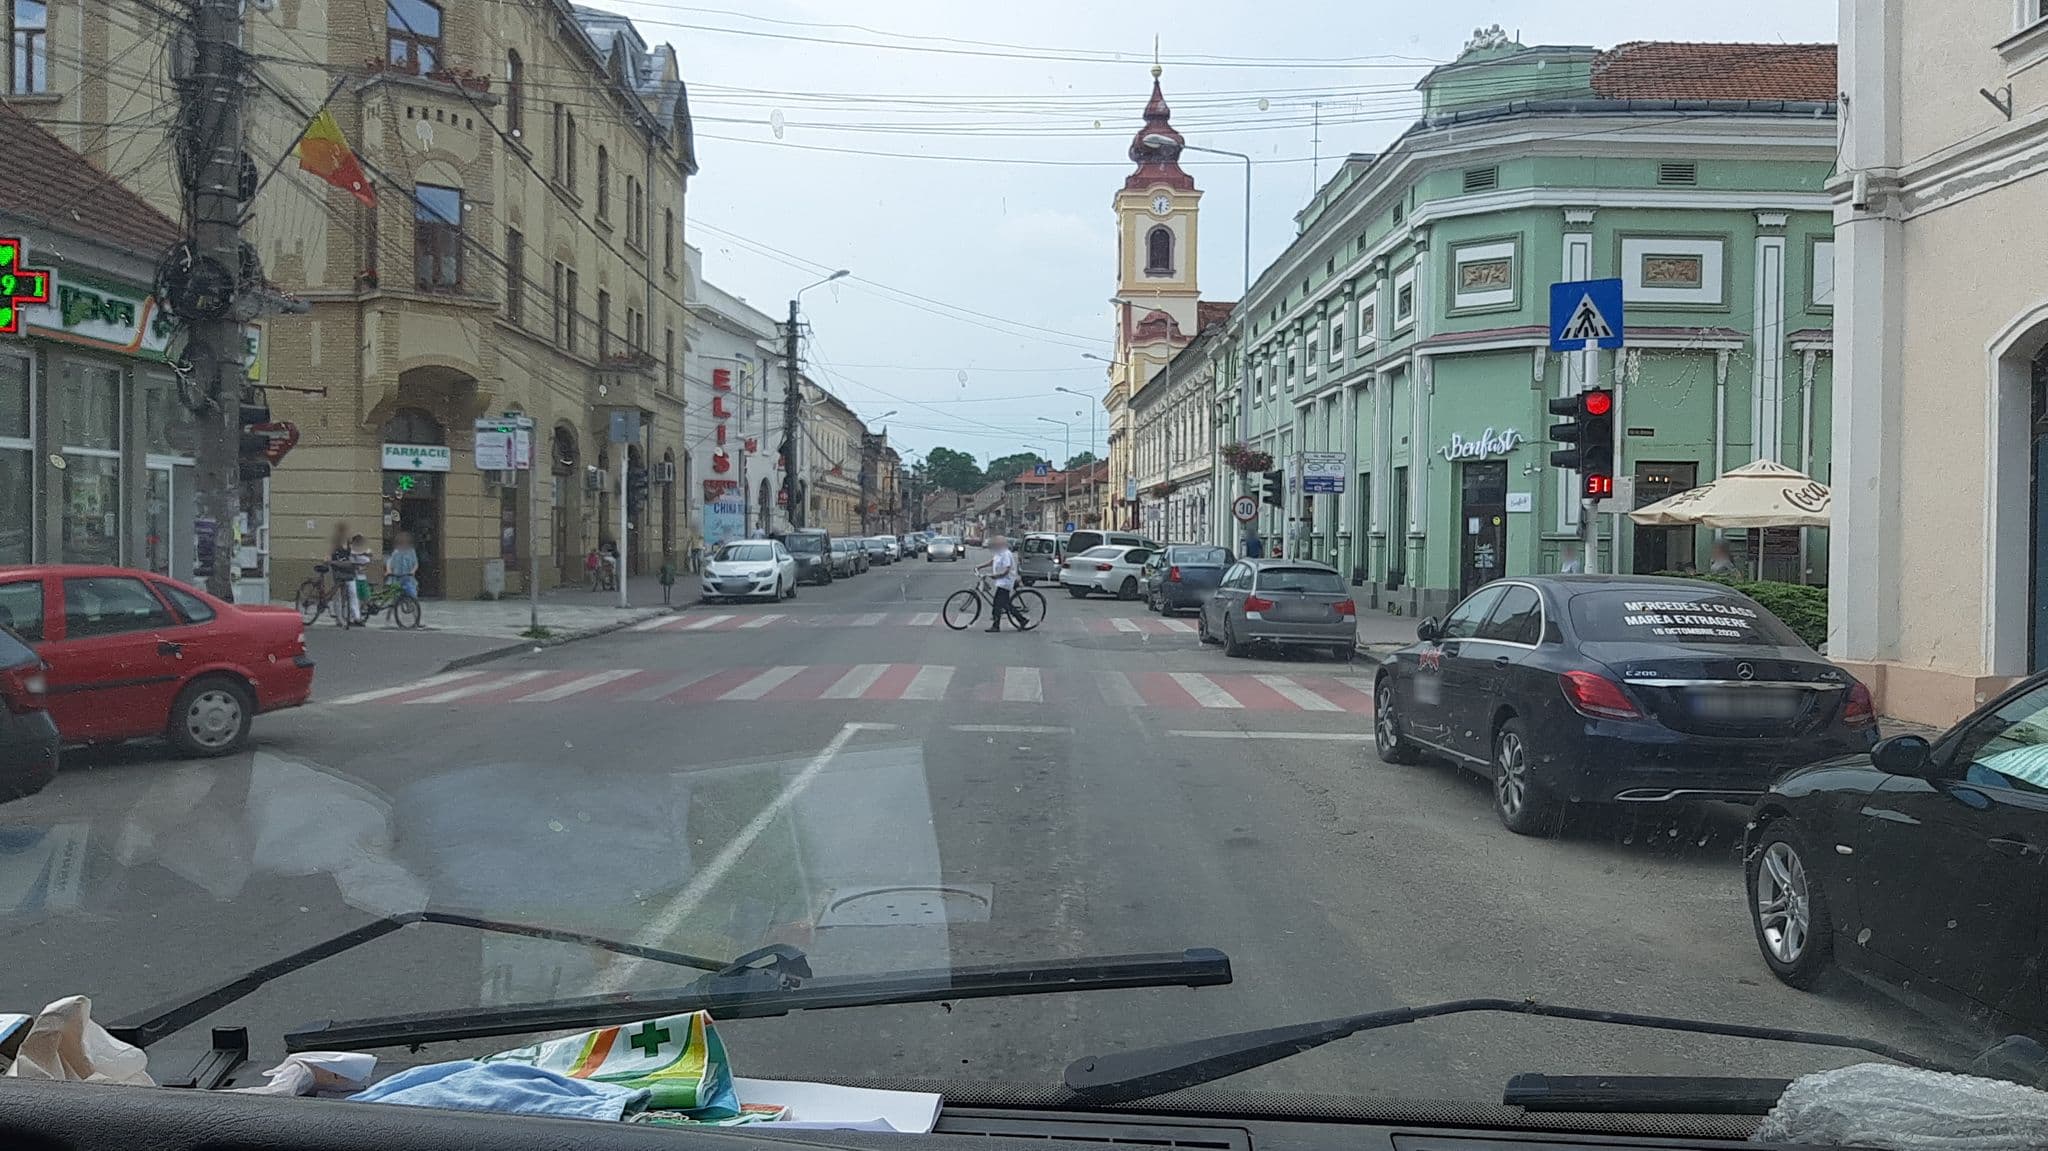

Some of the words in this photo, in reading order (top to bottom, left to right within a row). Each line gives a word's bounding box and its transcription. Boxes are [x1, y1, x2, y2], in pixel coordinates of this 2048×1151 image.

[712, 368, 732, 474] ELIS
[385, 446, 449, 458] FARMACIE
[1437, 427, 1524, 461] Benfast
[1588, 477, 1610, 494] 31
[1782, 481, 1831, 513] Coca
[1238, 502, 1254, 516] 30
[1624, 602, 1701, 612] MERCEDES
[1702, 604, 1713, 613] C
[1713, 604, 1757, 618] CLASS
[1624, 615, 1673, 626] MAREA
[1673, 615, 1751, 629] EXTRAGERE
